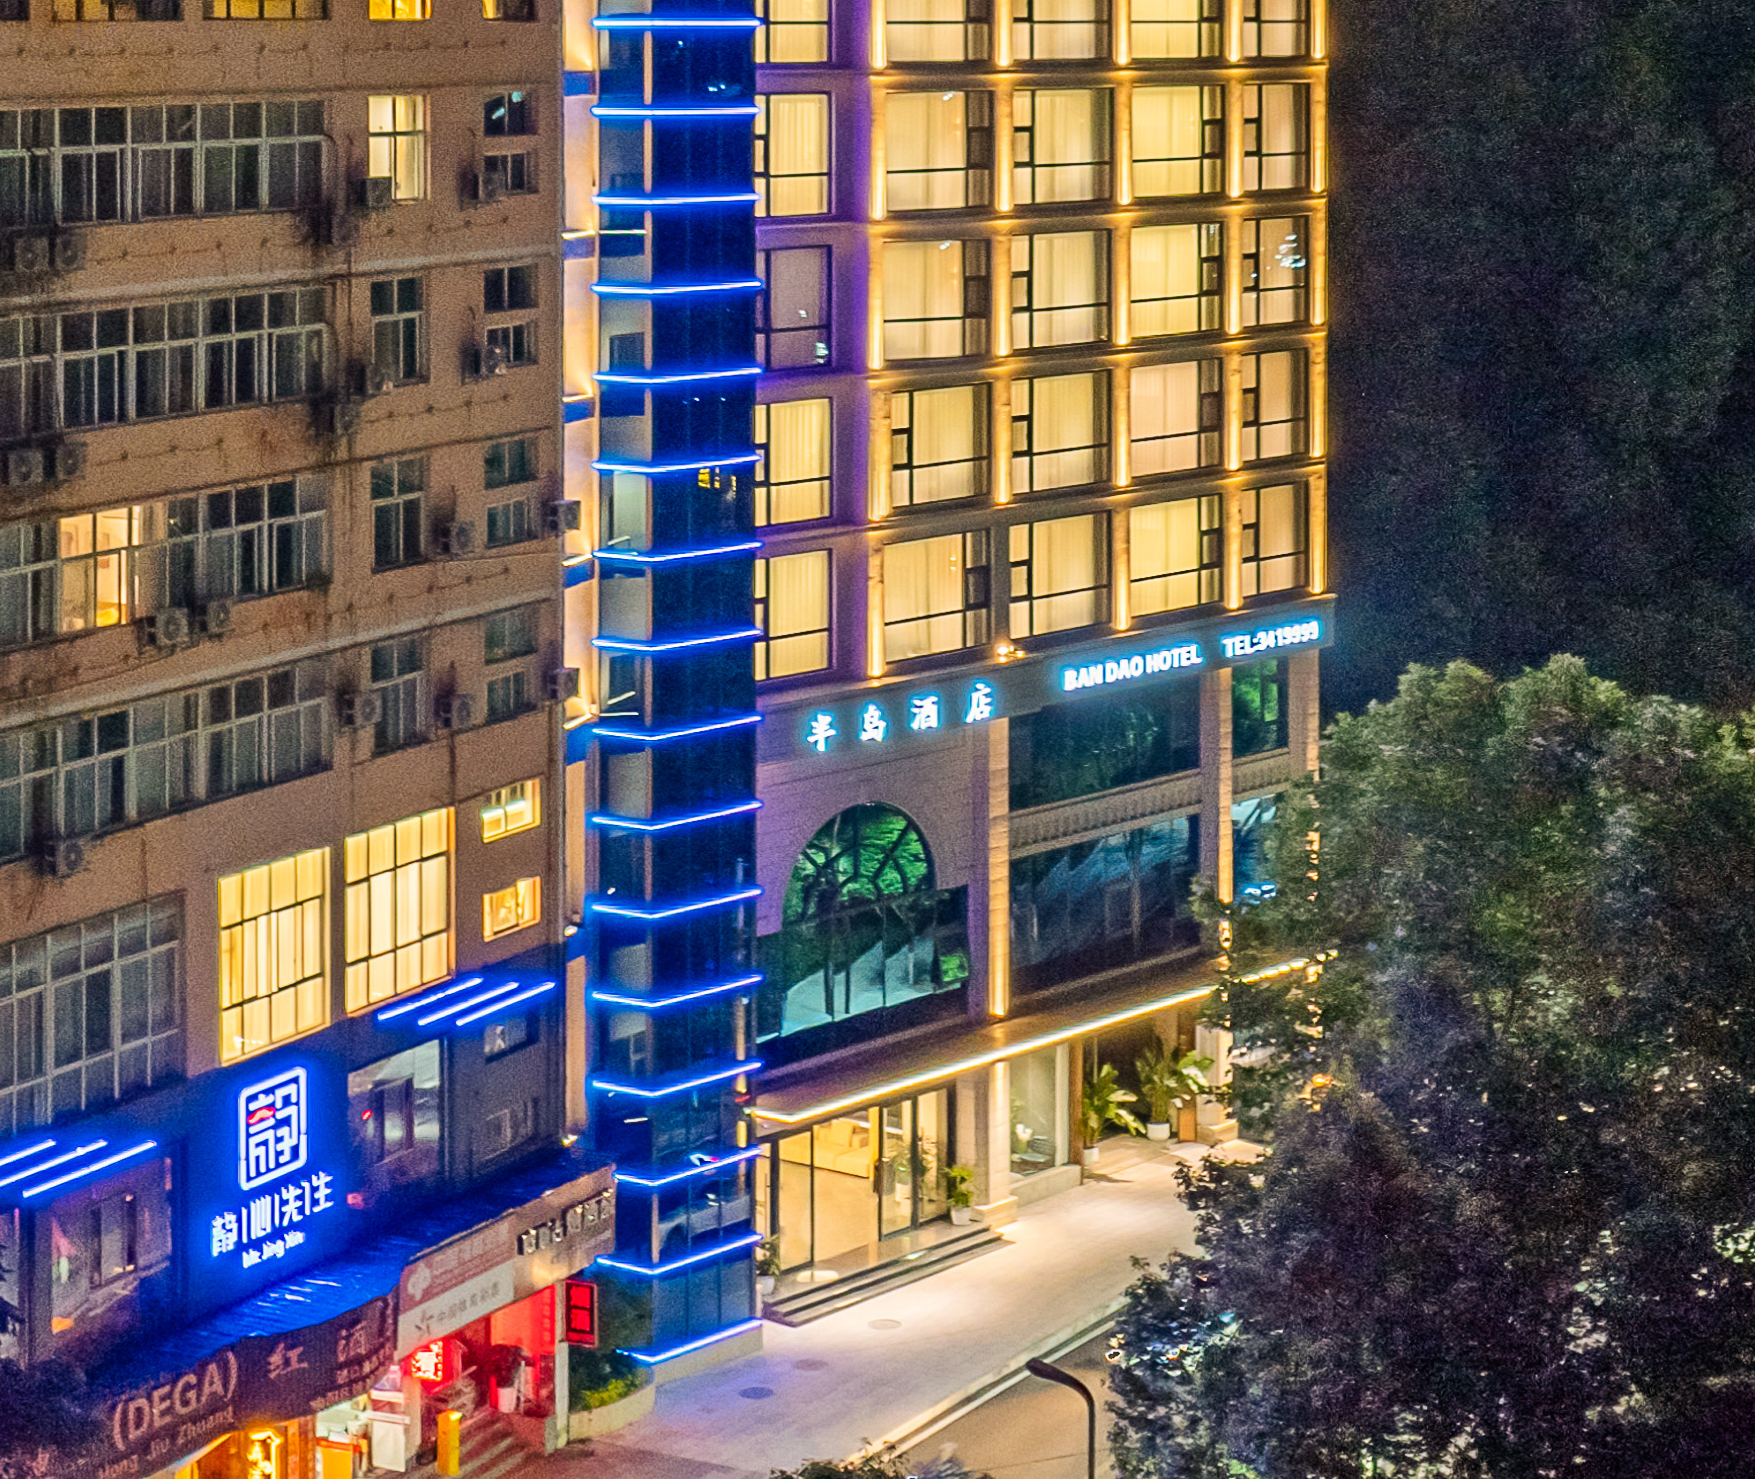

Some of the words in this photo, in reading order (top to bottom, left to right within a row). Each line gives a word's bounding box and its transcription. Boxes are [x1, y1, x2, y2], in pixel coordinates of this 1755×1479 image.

[1063, 663, 1104, 692] BAN
[1105, 655, 1145, 684] DAO
[1146, 644, 1203, 674] HOTEL
[806, 682, 993, 753] 半岛酒店
[112, 1350, 238, 1452] (DEGA)
